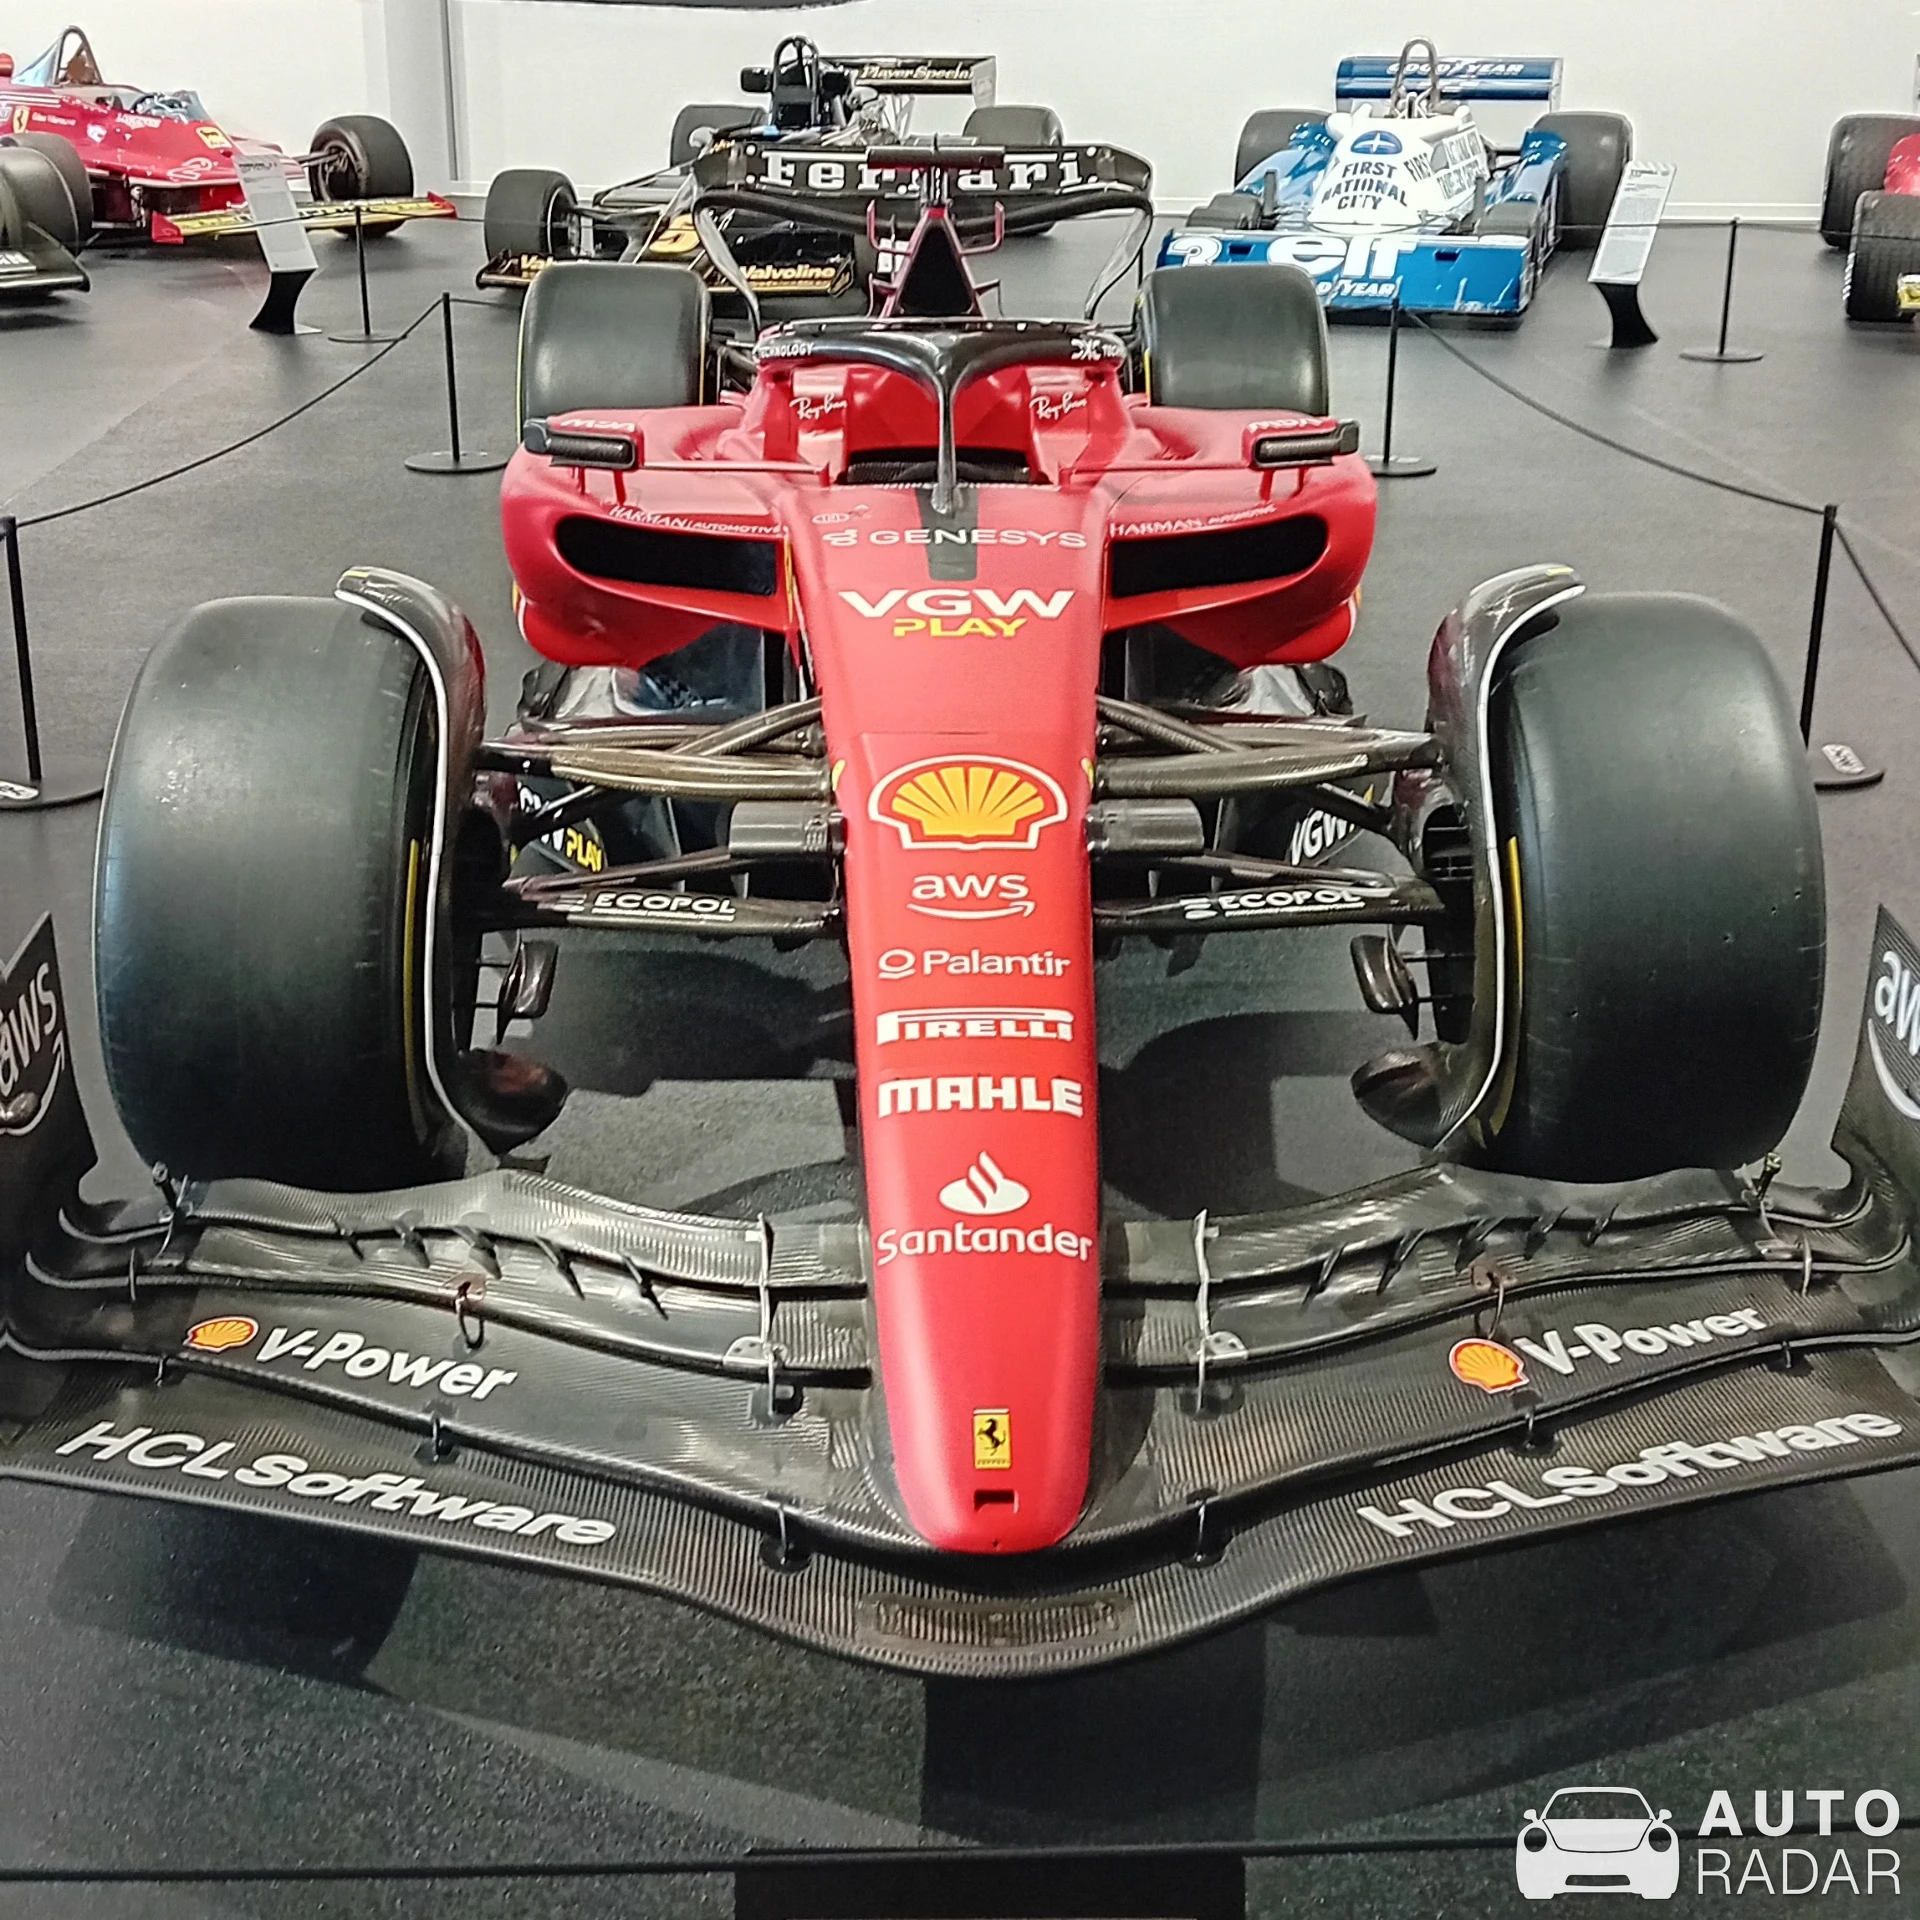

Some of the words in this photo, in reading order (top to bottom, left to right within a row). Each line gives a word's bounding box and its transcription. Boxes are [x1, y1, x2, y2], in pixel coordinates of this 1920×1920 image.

[1342, 161, 1398, 178] FIRST
[1321, 178, 1408, 207] NATIONAL
[1337, 195, 1383, 210] CITY
[649, 212, 701, 253] 5
[1267, 234, 1418, 279] elf
[608, 505, 687, 529] HARMAN
[1110, 518, 1203, 536] HARMAN
[870, 529, 1088, 548] GENESYS
[838, 589, 1076, 618] VGW
[893, 618, 1027, 637] PLAY
[566, 827, 602, 872] PLAY
[912, 874, 1029, 900] aws
[1218, 889, 1362, 910] ECOPOL
[594, 893, 736, 914] ECOPOL
[923, 949, 1071, 977] Palantir
[876, 1008, 1073, 1046] PIRELLI
[878, 1076, 1083, 1118] MAHLE
[876, 1222, 1093, 1266] Santander
[1512, 1305, 1775, 1375] V-Power
[256, 1326, 518, 1400] V-Power
